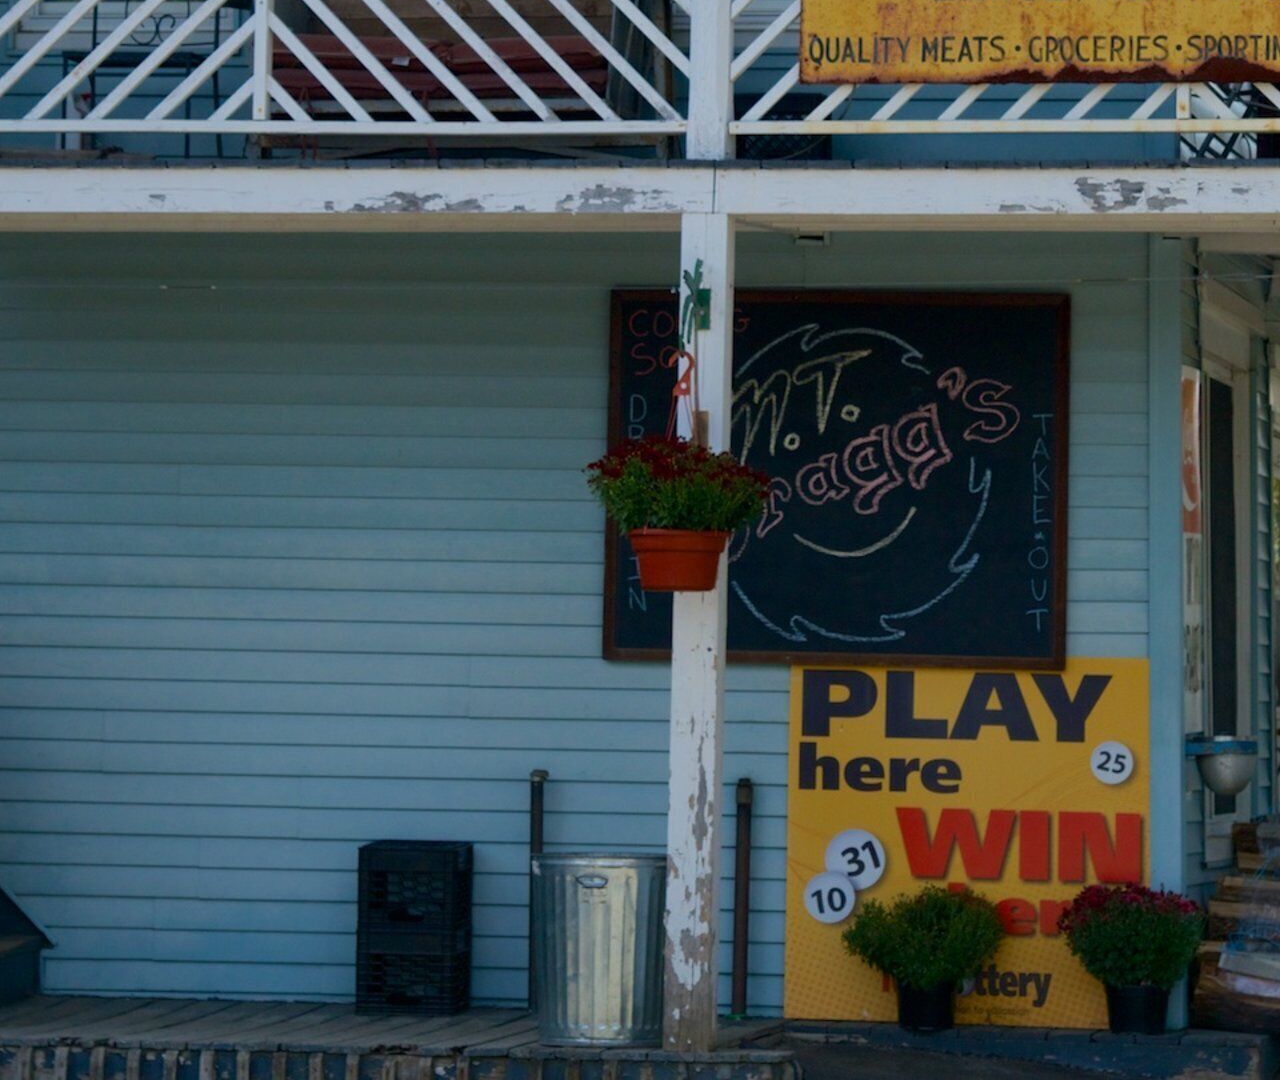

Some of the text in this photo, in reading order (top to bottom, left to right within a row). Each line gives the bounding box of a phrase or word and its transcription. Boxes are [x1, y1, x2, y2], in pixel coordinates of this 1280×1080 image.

[808, 35, 912, 65] QUALITY
[920, 35, 1006, 64] MEATS
[1028, 34, 1169, 64] GROCERIES
[800, 668, 1114, 743] PLAY
[798, 741, 963, 794] here
[1095, 750, 1127, 776] 25
[840, 840, 882, 878] 31
[895, 806, 1144, 884] WIN
[810, 886, 847, 915] 10
[970, 964, 1052, 1008] ttery
